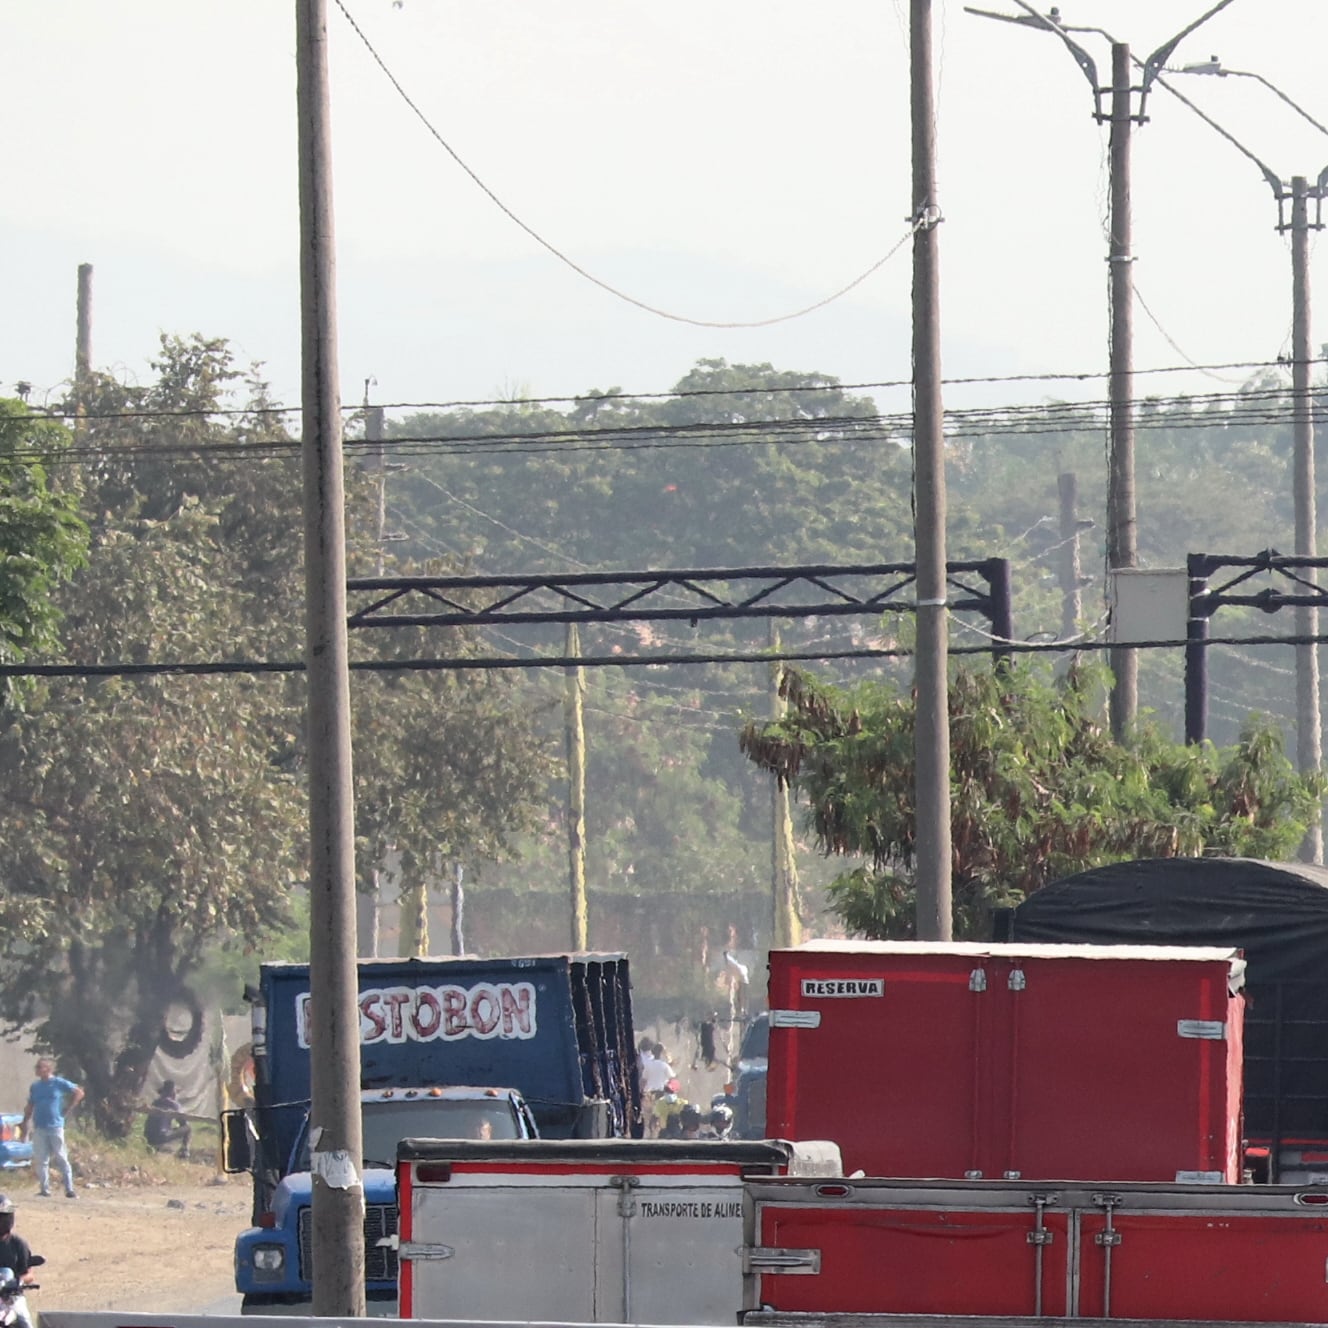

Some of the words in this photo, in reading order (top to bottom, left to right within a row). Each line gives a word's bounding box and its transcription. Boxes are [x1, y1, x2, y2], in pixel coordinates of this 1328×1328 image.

[805, 982, 878, 994] RESERVA
[641, 1203, 699, 1218] TRANSPORTE
[701, 1203, 712, 1218] DE
